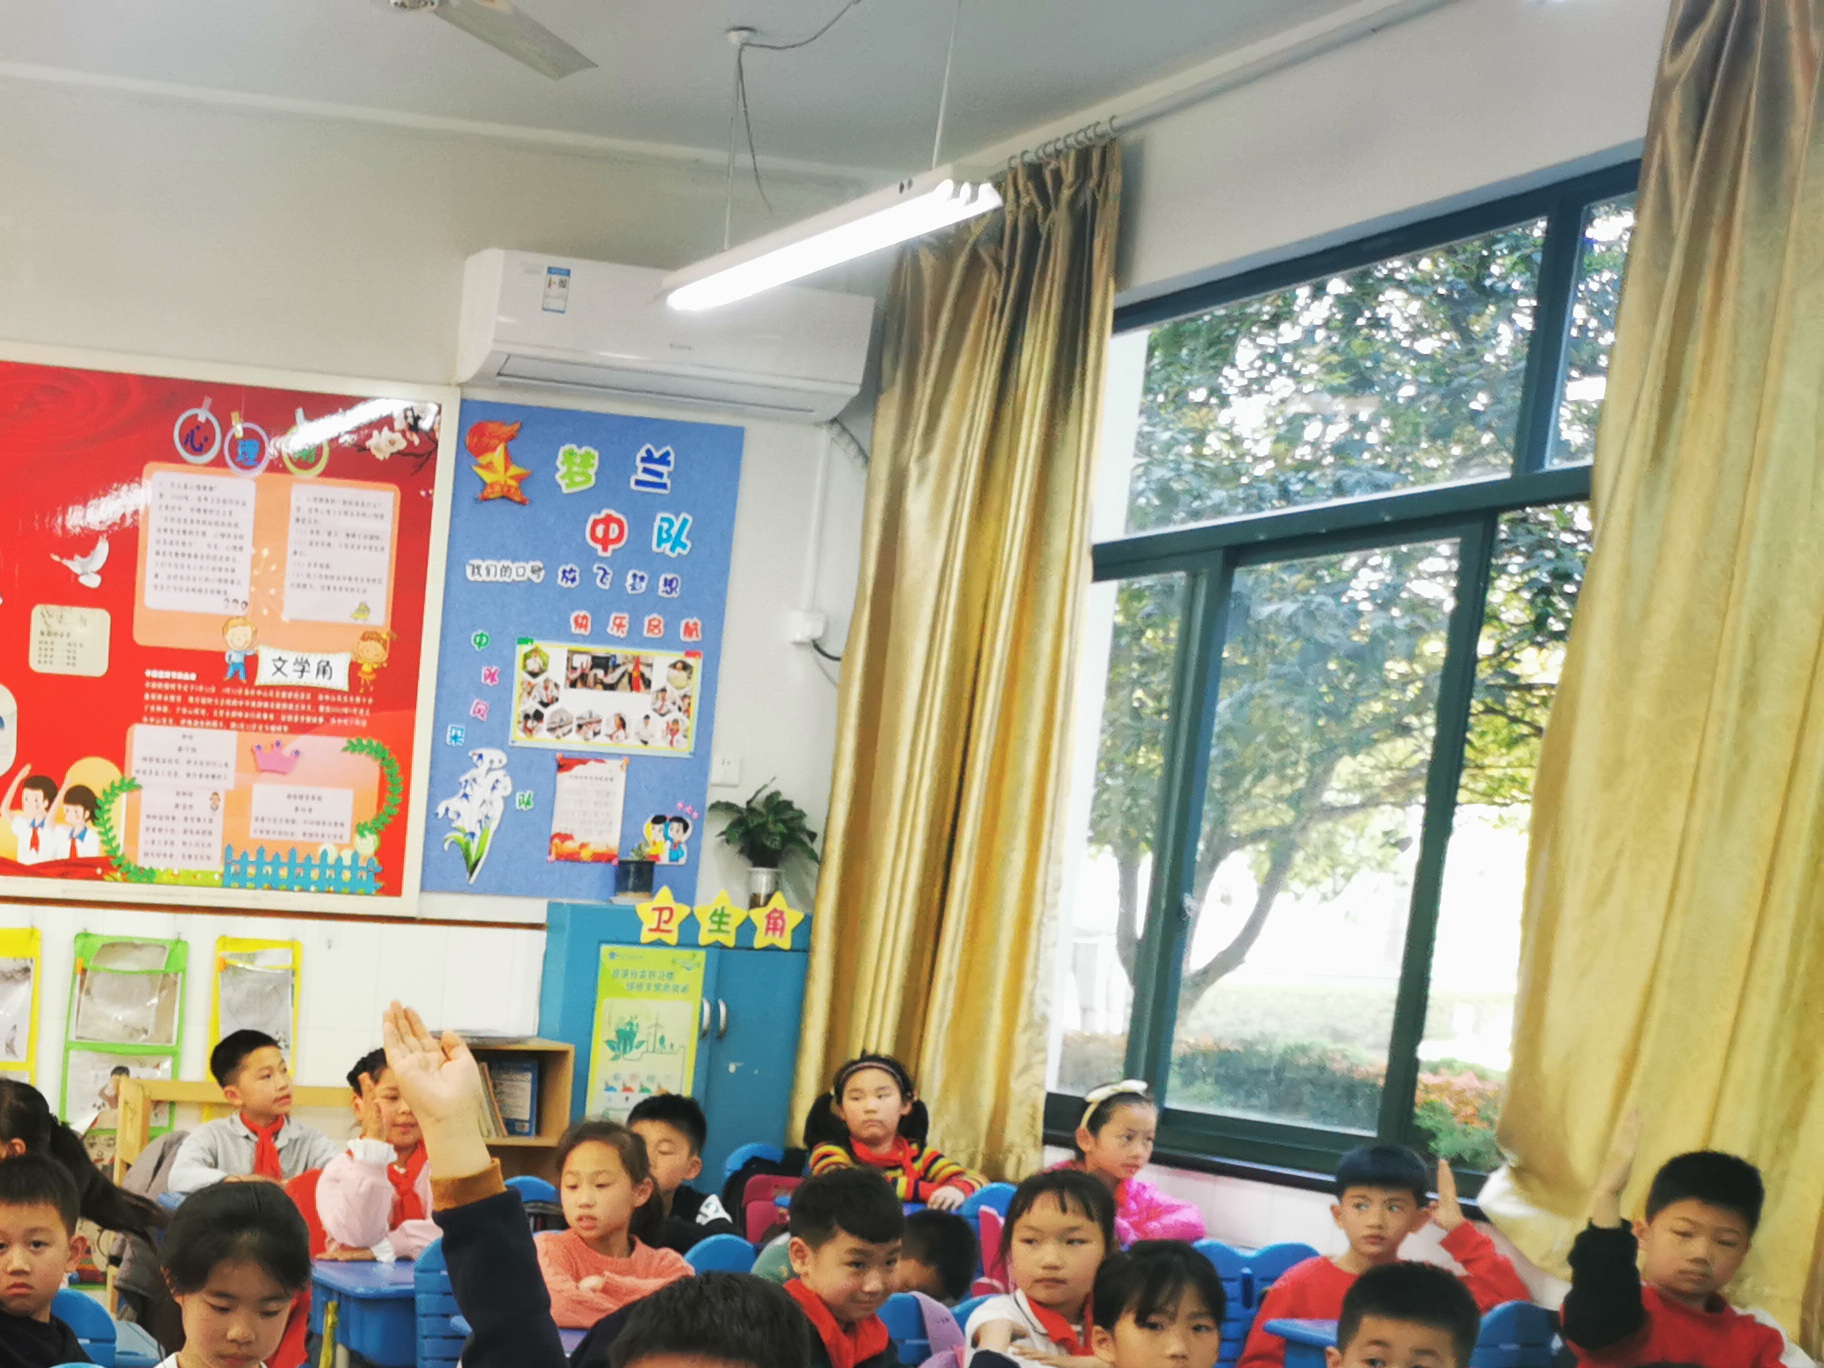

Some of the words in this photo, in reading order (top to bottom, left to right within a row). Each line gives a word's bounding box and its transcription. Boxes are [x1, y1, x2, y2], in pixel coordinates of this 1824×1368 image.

[588, 511, 691, 555] 中队
[468, 562, 545, 581] 我们的口号
[271, 655, 334, 681] 文学角
[647, 905, 787, 939] 卫生角
